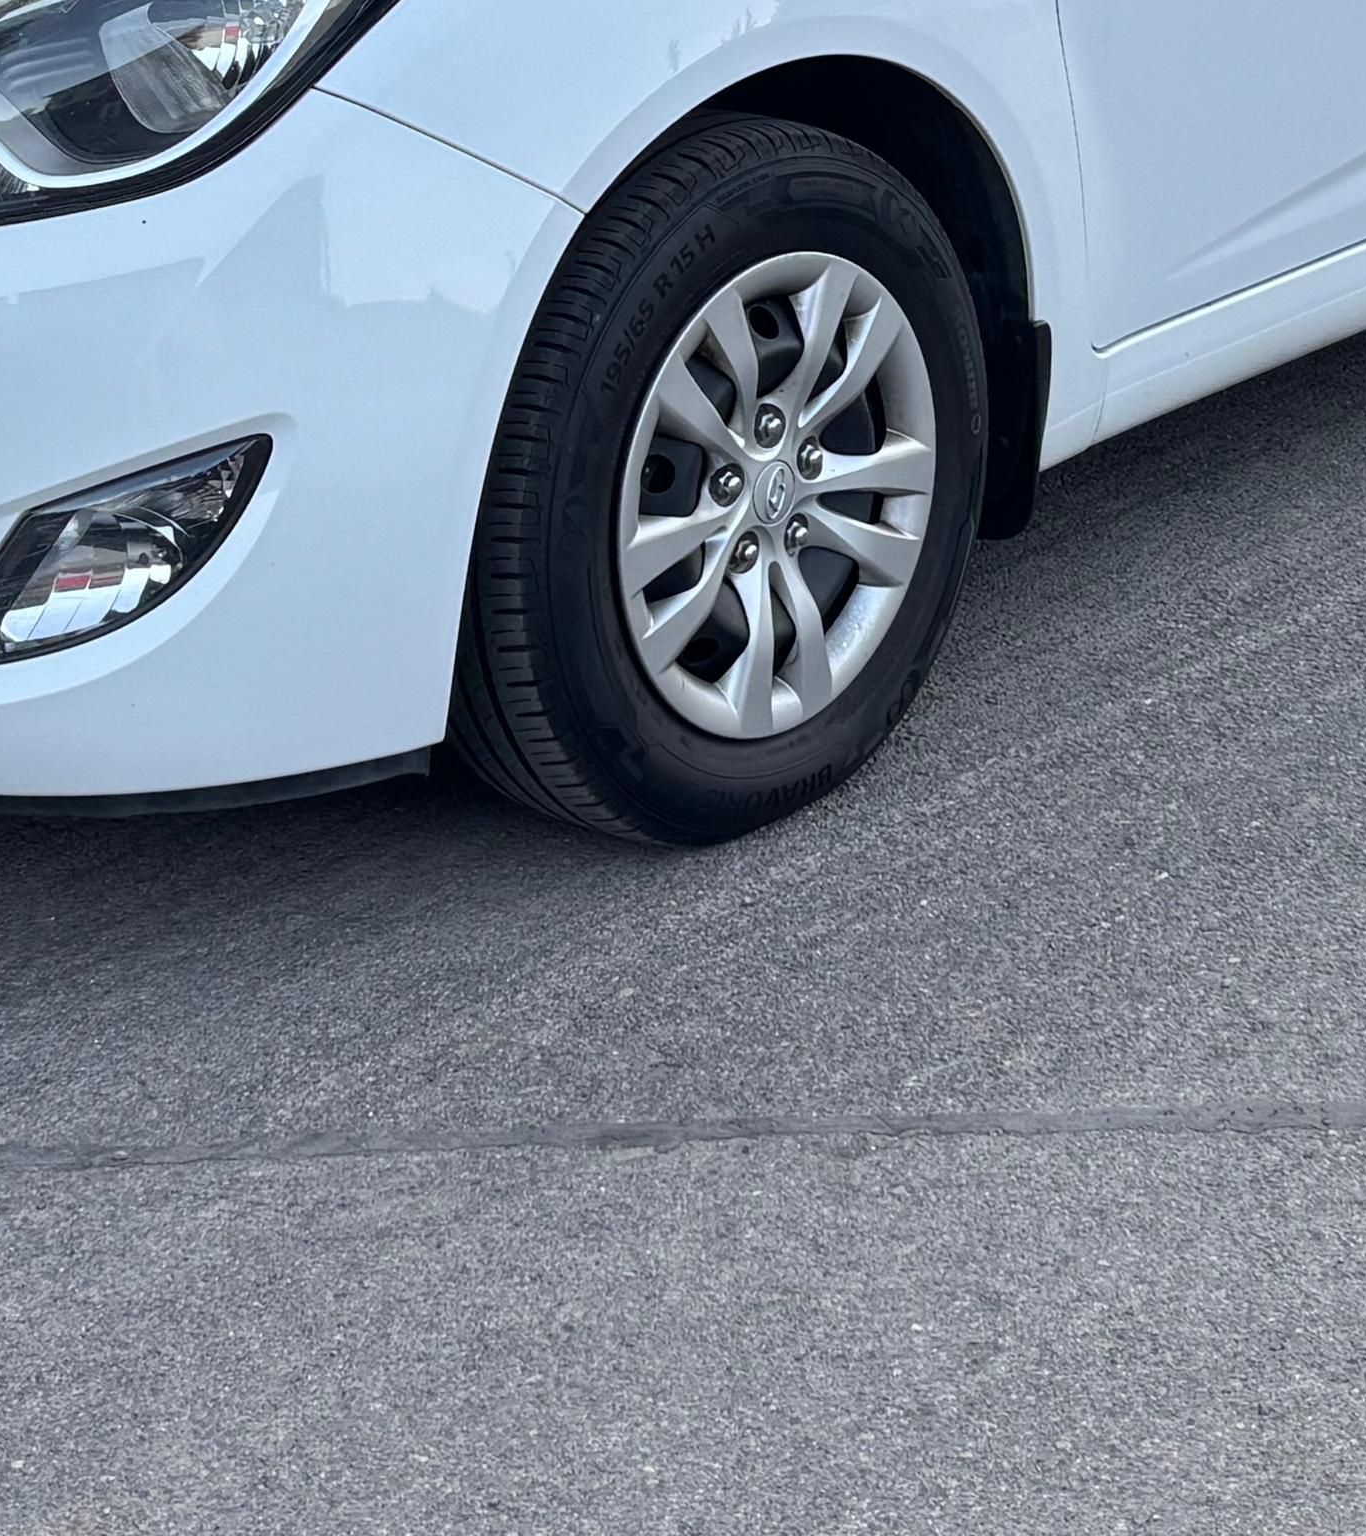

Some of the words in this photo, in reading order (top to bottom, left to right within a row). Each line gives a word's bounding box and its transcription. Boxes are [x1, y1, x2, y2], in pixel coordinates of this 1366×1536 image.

[600, 301, 655, 394] 195/65
[653, 271, 673, 299] R
[670, 243, 696, 274] 15
[694, 223, 716, 252] H
